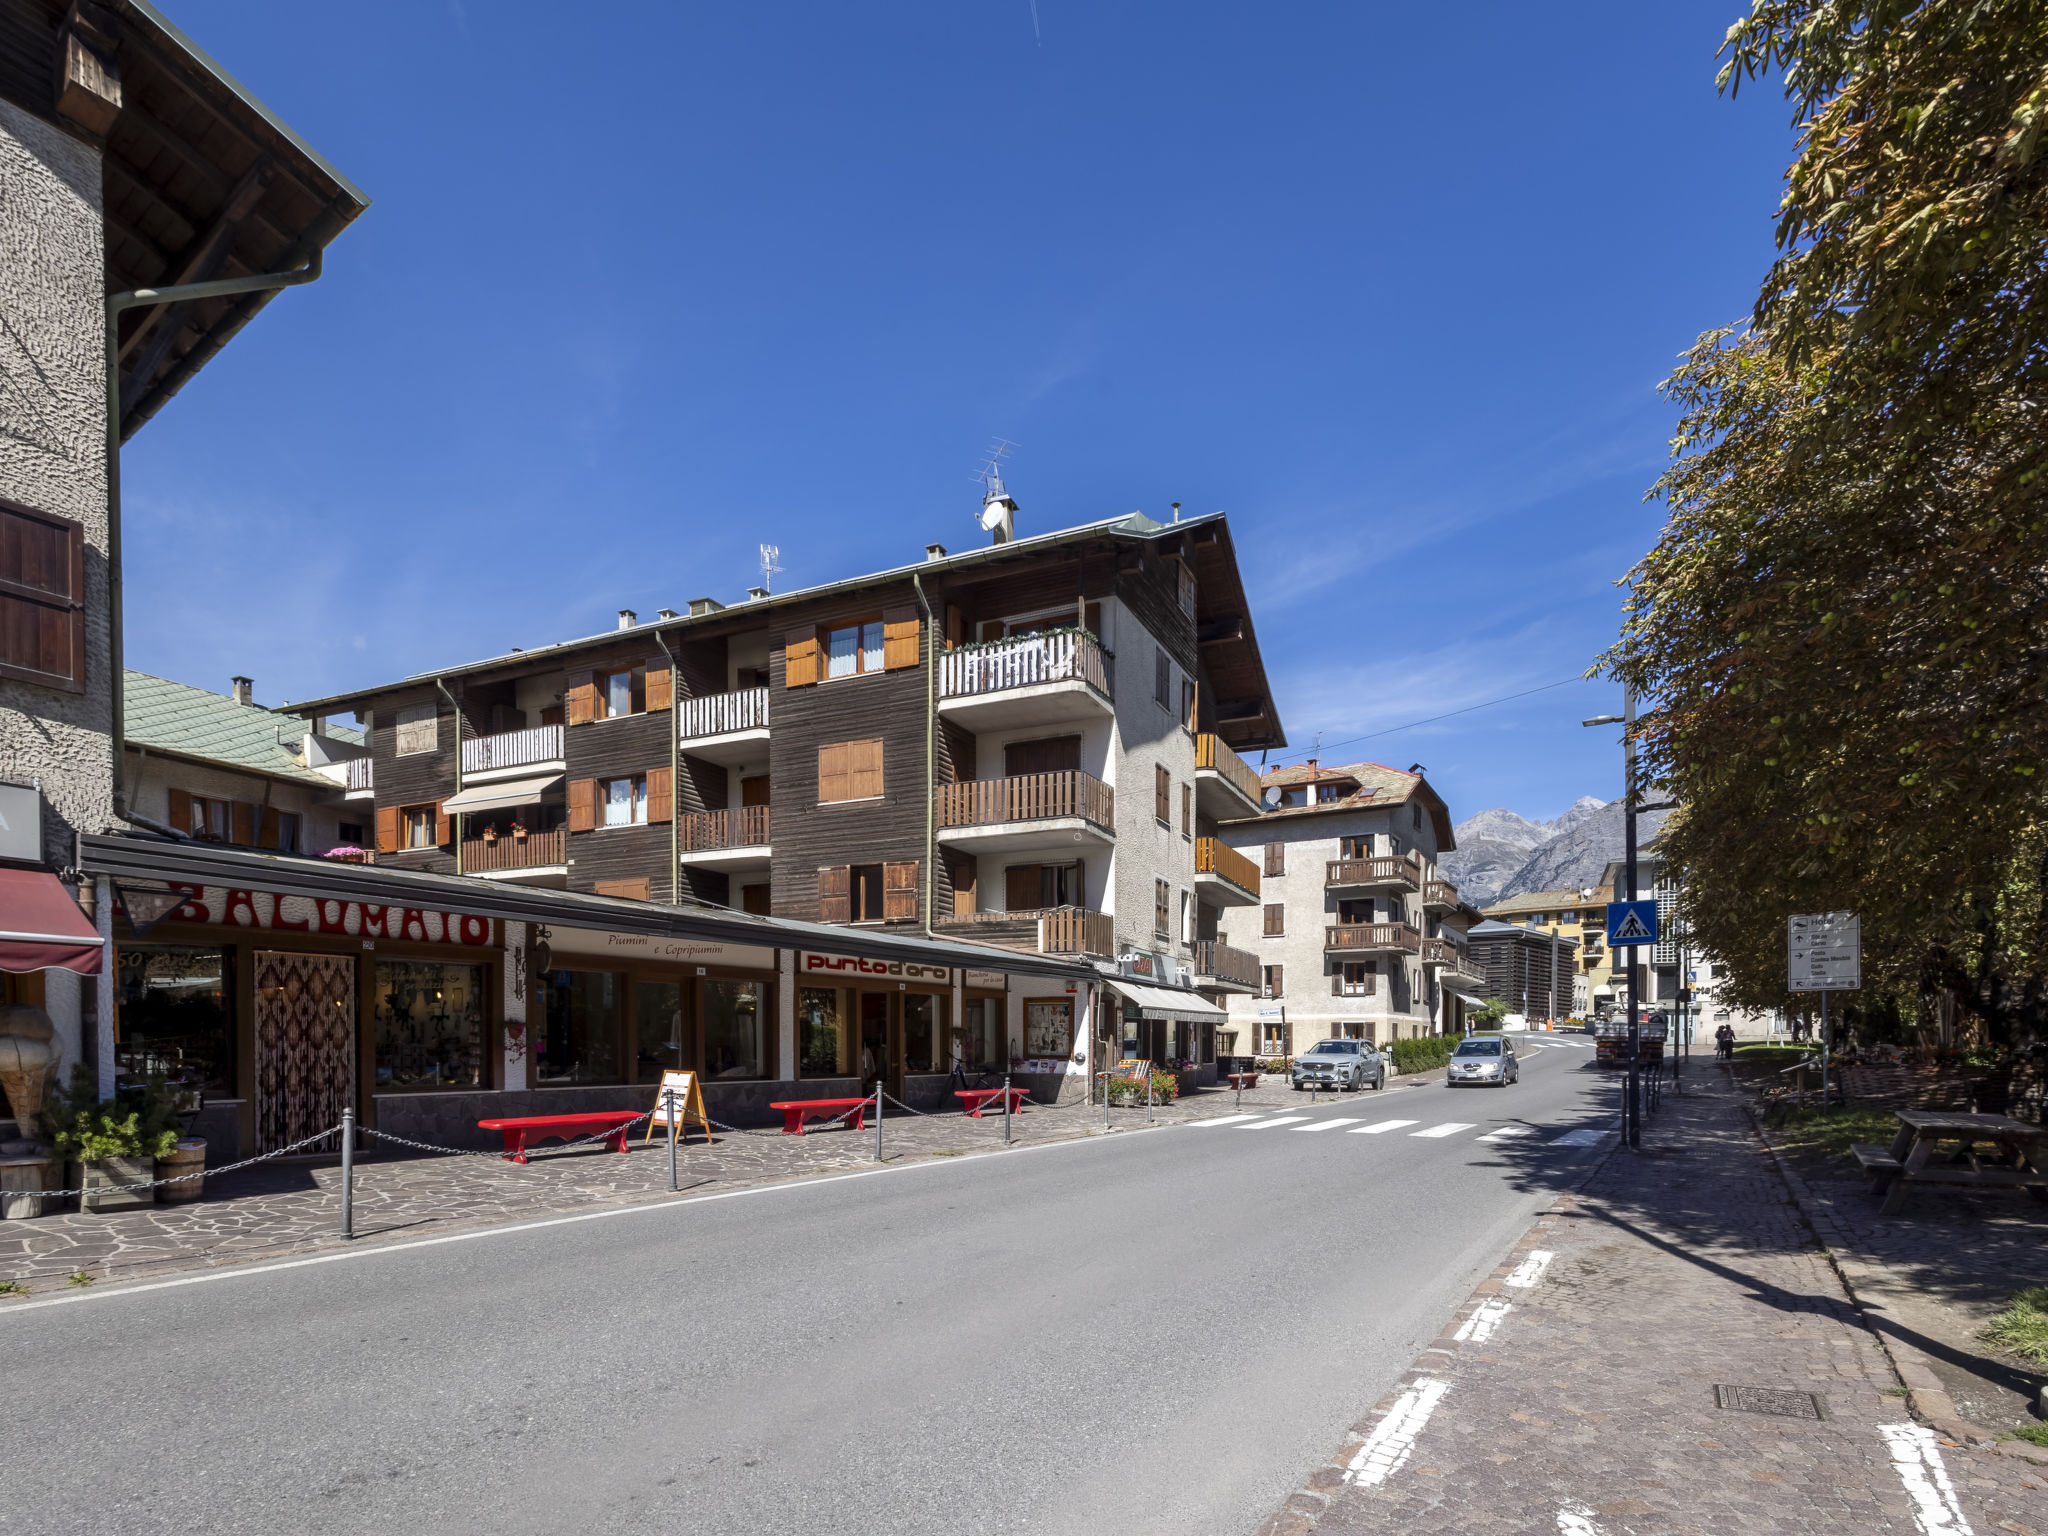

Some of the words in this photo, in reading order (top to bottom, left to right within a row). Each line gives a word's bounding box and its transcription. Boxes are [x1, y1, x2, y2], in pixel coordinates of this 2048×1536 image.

[168, 881, 490, 946] SALUMAIO
[1811, 918, 1834, 926] Hotel
[608, 935, 648, 945] Piumini
[654, 946, 660, 954] e
[665, 944, 723, 958] Copripiumini
